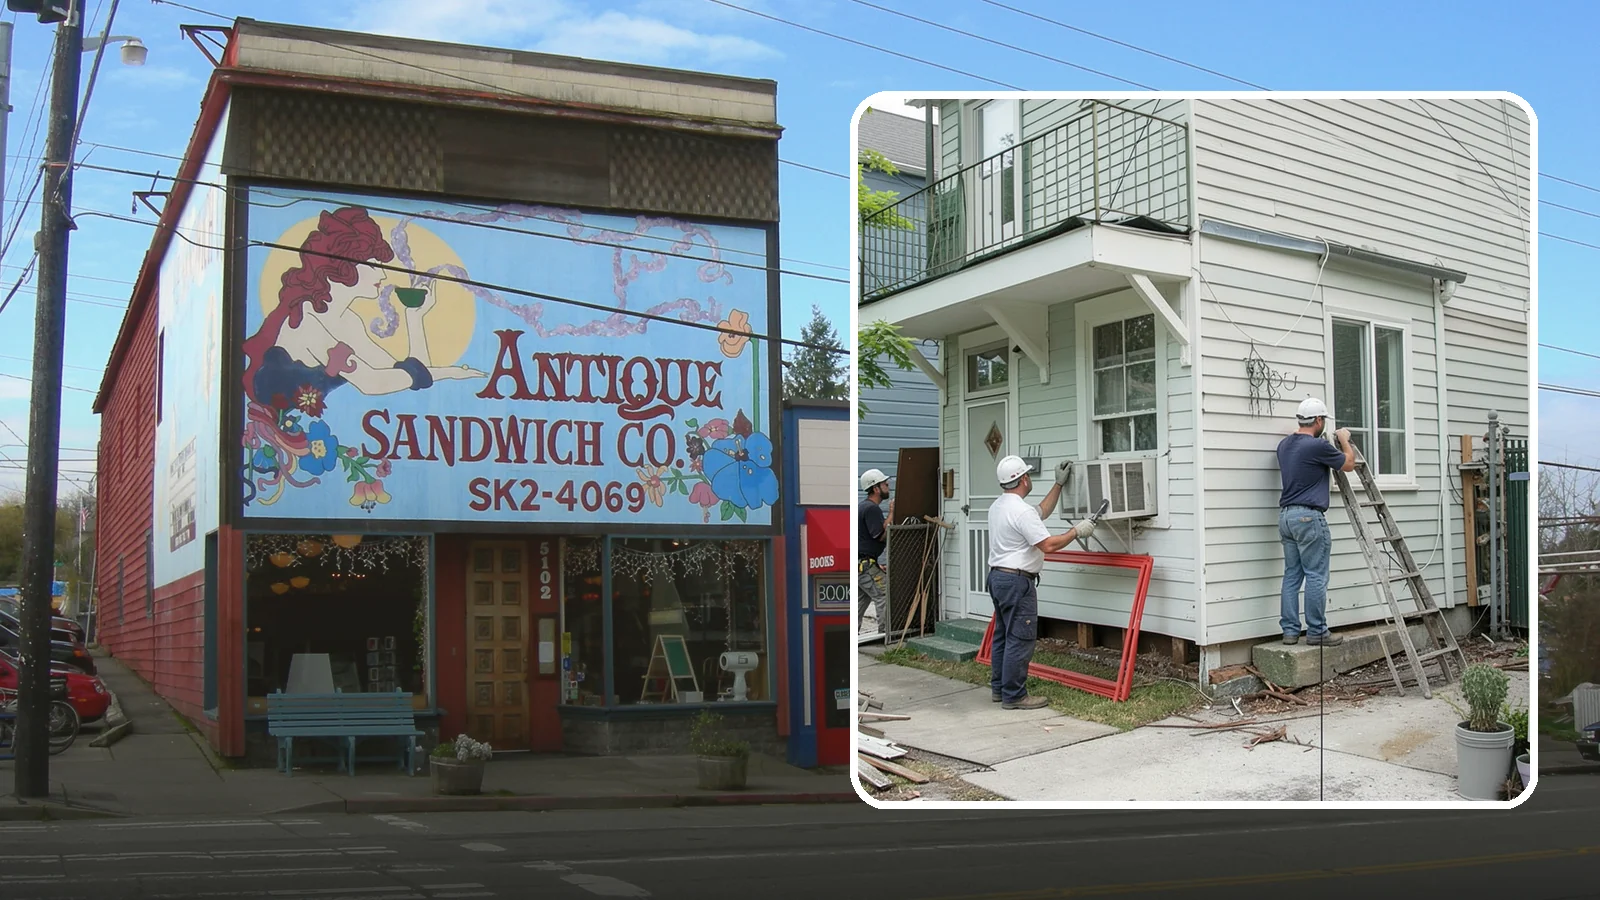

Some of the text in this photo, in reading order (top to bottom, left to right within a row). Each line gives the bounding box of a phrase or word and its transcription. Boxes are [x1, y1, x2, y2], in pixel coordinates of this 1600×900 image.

[475, 329, 723, 421] ANTIQUE
[361, 408, 685, 469] SANDWICH CO.
[469, 477, 645, 513] SK2-4069
[539, 541, 552, 600] 5102
[809, 555, 835, 569] BOOKS
